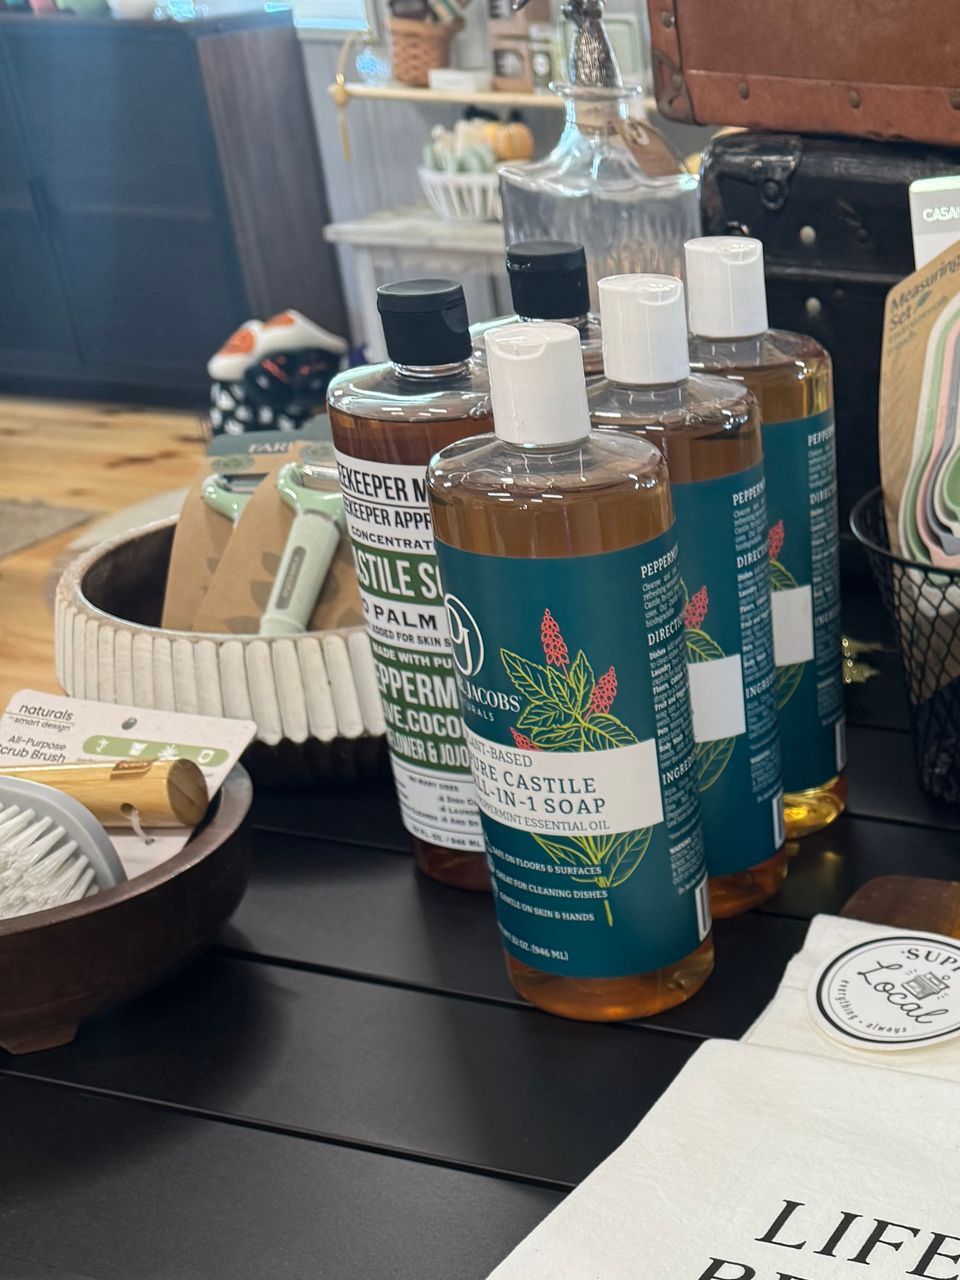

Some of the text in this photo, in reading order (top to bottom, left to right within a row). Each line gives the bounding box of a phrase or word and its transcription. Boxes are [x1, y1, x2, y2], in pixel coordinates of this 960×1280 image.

[336, 462, 409, 502] EEKEEPER
[343, 494, 391, 528] EEKEEPER
[373, 604, 438, 631] PALM
[372, 624, 395, 640] ADDED
[396, 630, 415, 645] FOR
[417, 636, 442, 648] SKIN
[397, 650, 431, 667] WITH
[375, 659, 459, 710] EPPERM
[465, 680, 521, 713] JACOBS
[18, 704, 74, 721] naturals
[14, 718, 71, 733] smart design
[8, 735, 67, 751] All-Purpose
[426, 741, 438, 763] &
[31, 749, 66, 764] Brush
[503, 771, 597, 794] CASTILE
[545, 797, 606, 815] SOAP
[524, 817, 588, 832] ESSENTIAL
[589, 819, 610, 831] OIL
[515, 858, 546, 873] FLOORS
[547, 865, 554, 873] &
[555, 866, 602, 875] SURFACES
[513, 878, 528, 890] FOR
[528, 884, 572, 899] CLEANING
[573, 890, 608, 899] DISHES
[521, 903, 533, 913] ON
[533, 907, 553, 918] SKIN
[562, 912, 595, 922] HANDS
[857, 961, 949, 1024] Local
[835, 980, 908, 1034] everything always
